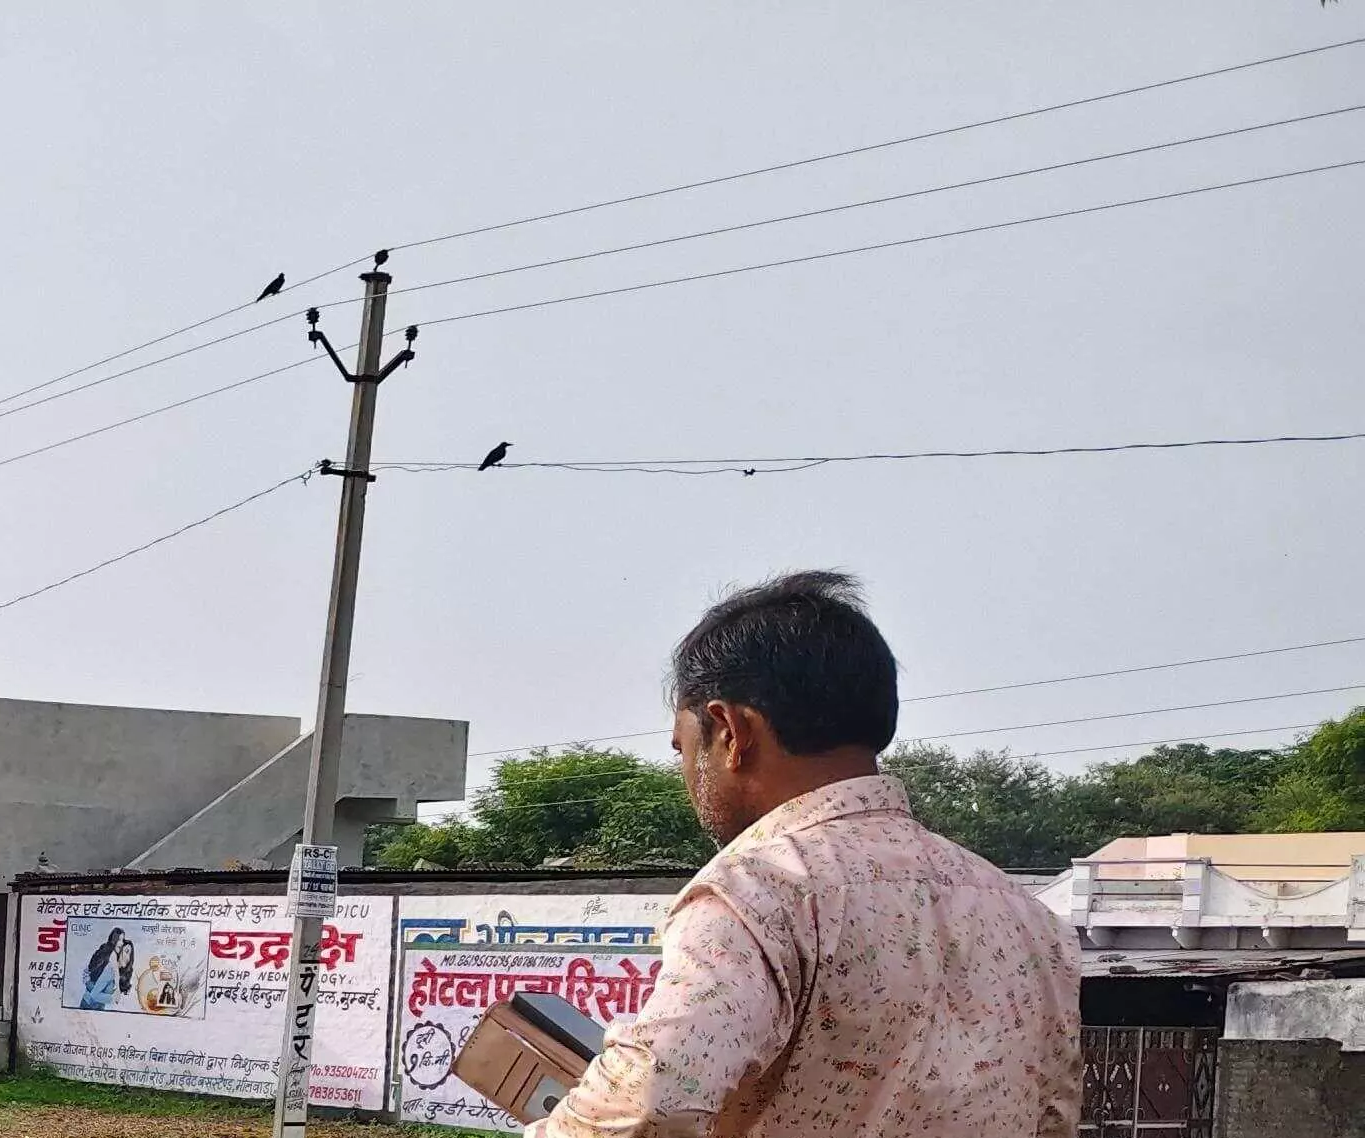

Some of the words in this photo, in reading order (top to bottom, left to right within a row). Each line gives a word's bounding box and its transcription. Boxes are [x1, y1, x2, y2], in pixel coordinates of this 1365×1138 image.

[83, 899, 102, 916] एवं
[236, 899, 249, 921] से
[335, 904, 370, 919] PICU
[209, 969, 250, 980] OWSHP
[408, 957, 493, 1018] होटल
